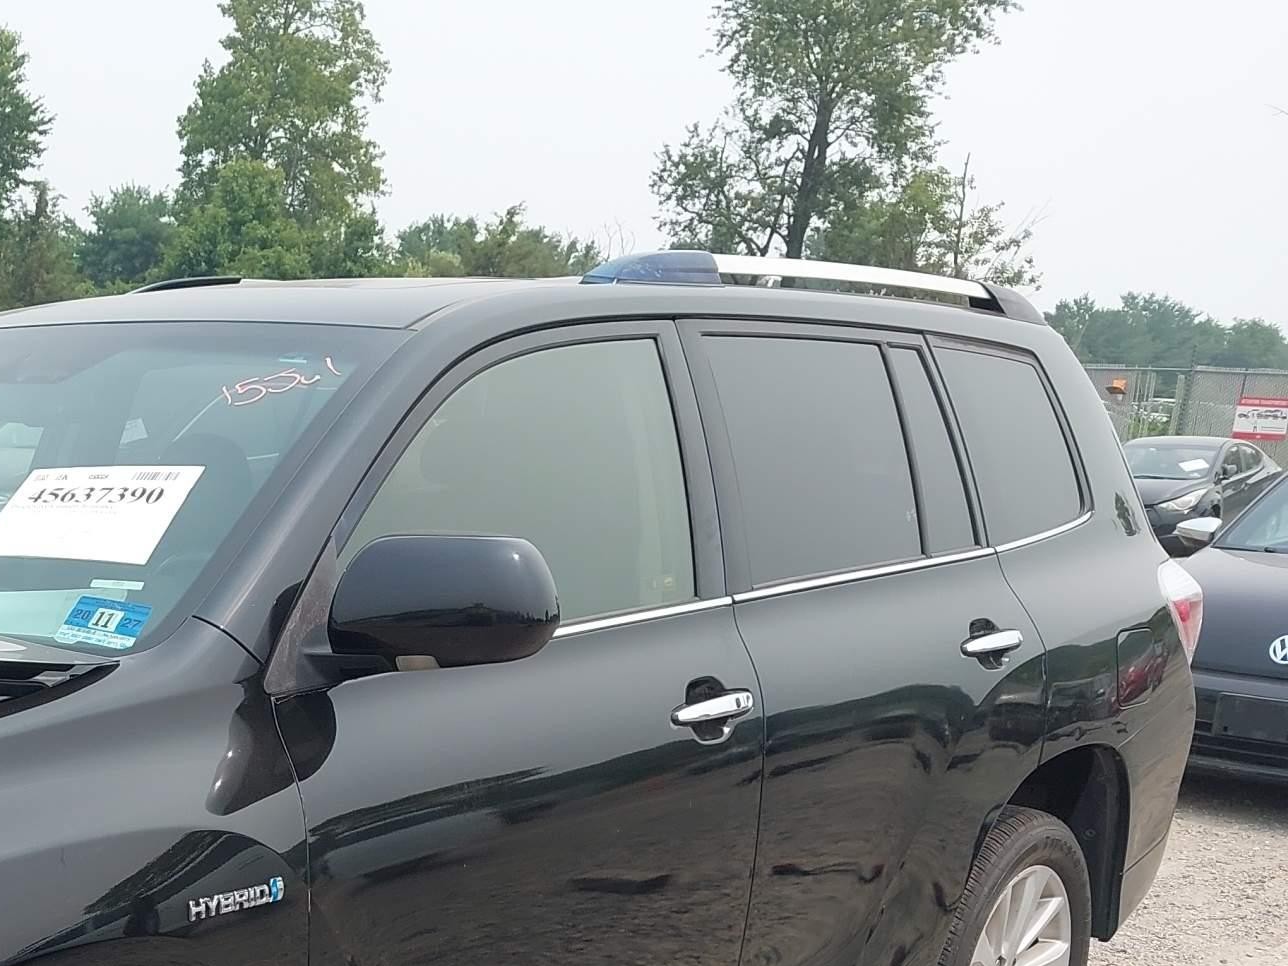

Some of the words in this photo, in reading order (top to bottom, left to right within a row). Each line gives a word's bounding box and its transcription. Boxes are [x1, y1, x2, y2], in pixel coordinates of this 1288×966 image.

[27, 486, 165, 505] 45637390
[91, 611, 114, 628] 11
[120, 618, 143, 629] 27
[188, 883, 271, 922] HYBRID
